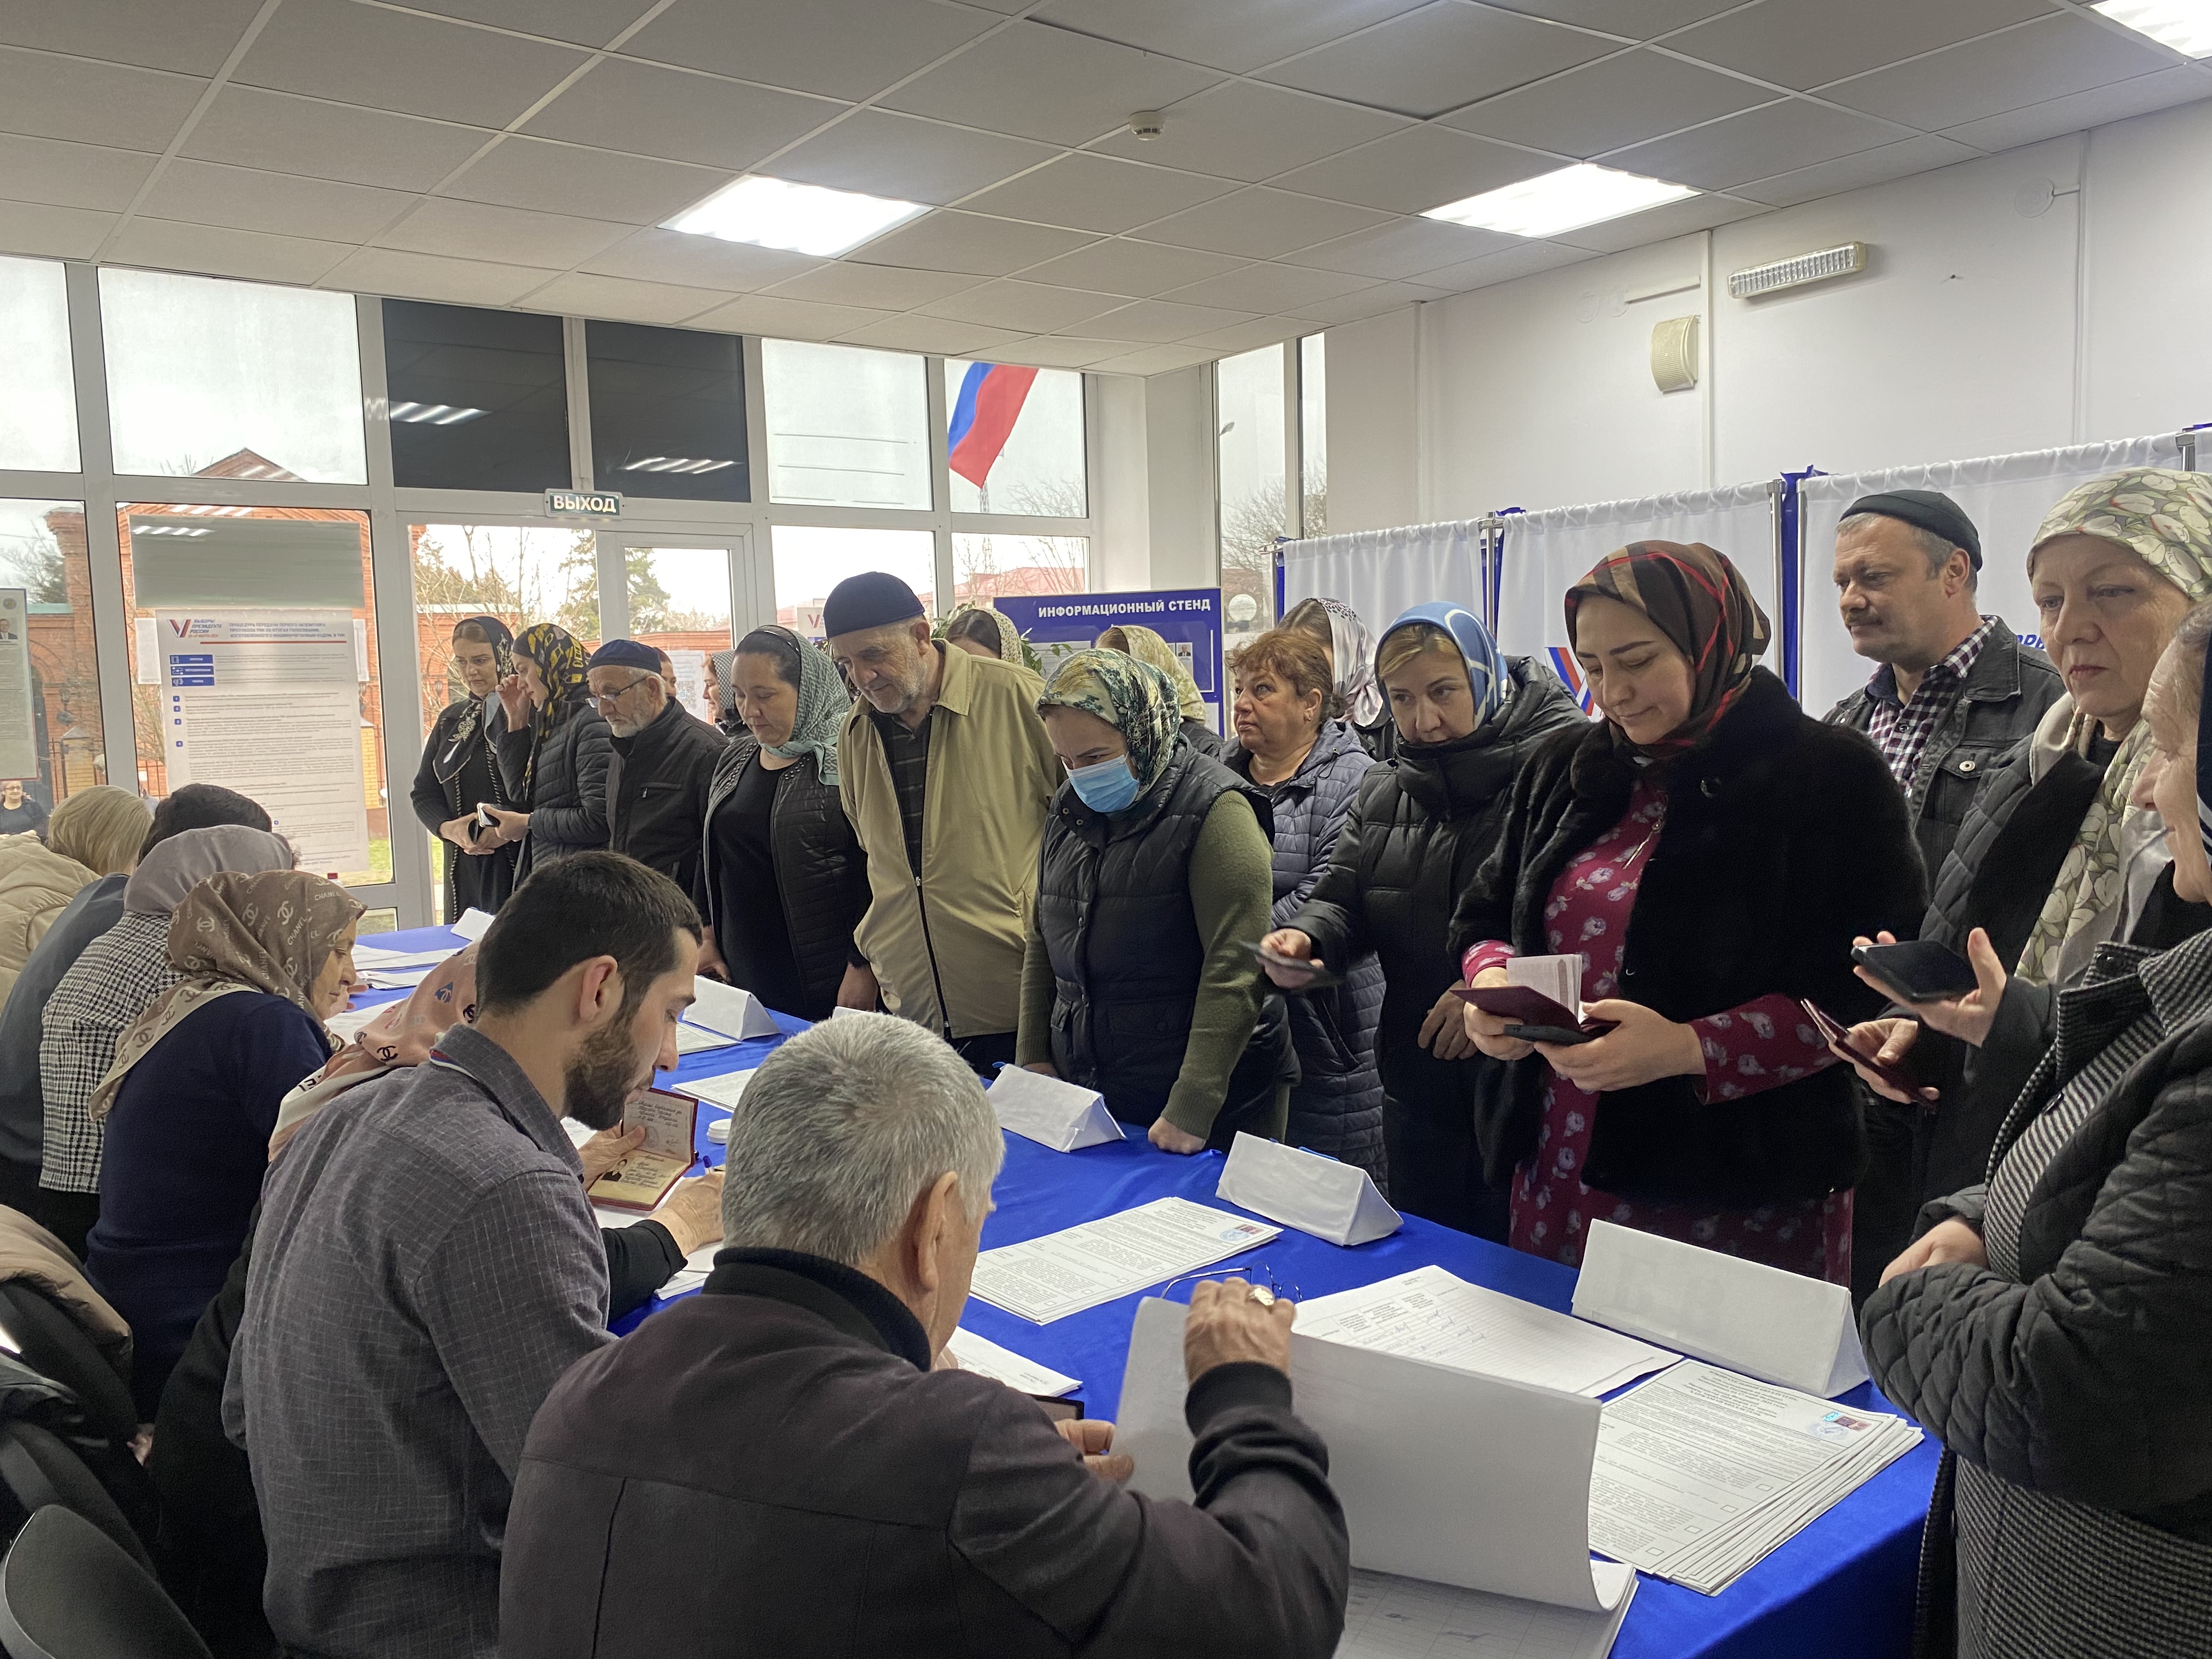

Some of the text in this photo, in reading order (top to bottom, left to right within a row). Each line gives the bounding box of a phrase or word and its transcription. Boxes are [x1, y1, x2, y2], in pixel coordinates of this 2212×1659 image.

[553, 495, 617, 513] ВЫХОД
[1038, 599, 1211, 618] ИНФОРМАЦИОННЫЙ СТЕНД
[314, 891, 341, 901] CHANEL
[287, 916, 308, 945] CHANEL
[258, 948, 269, 980] CHANEL
